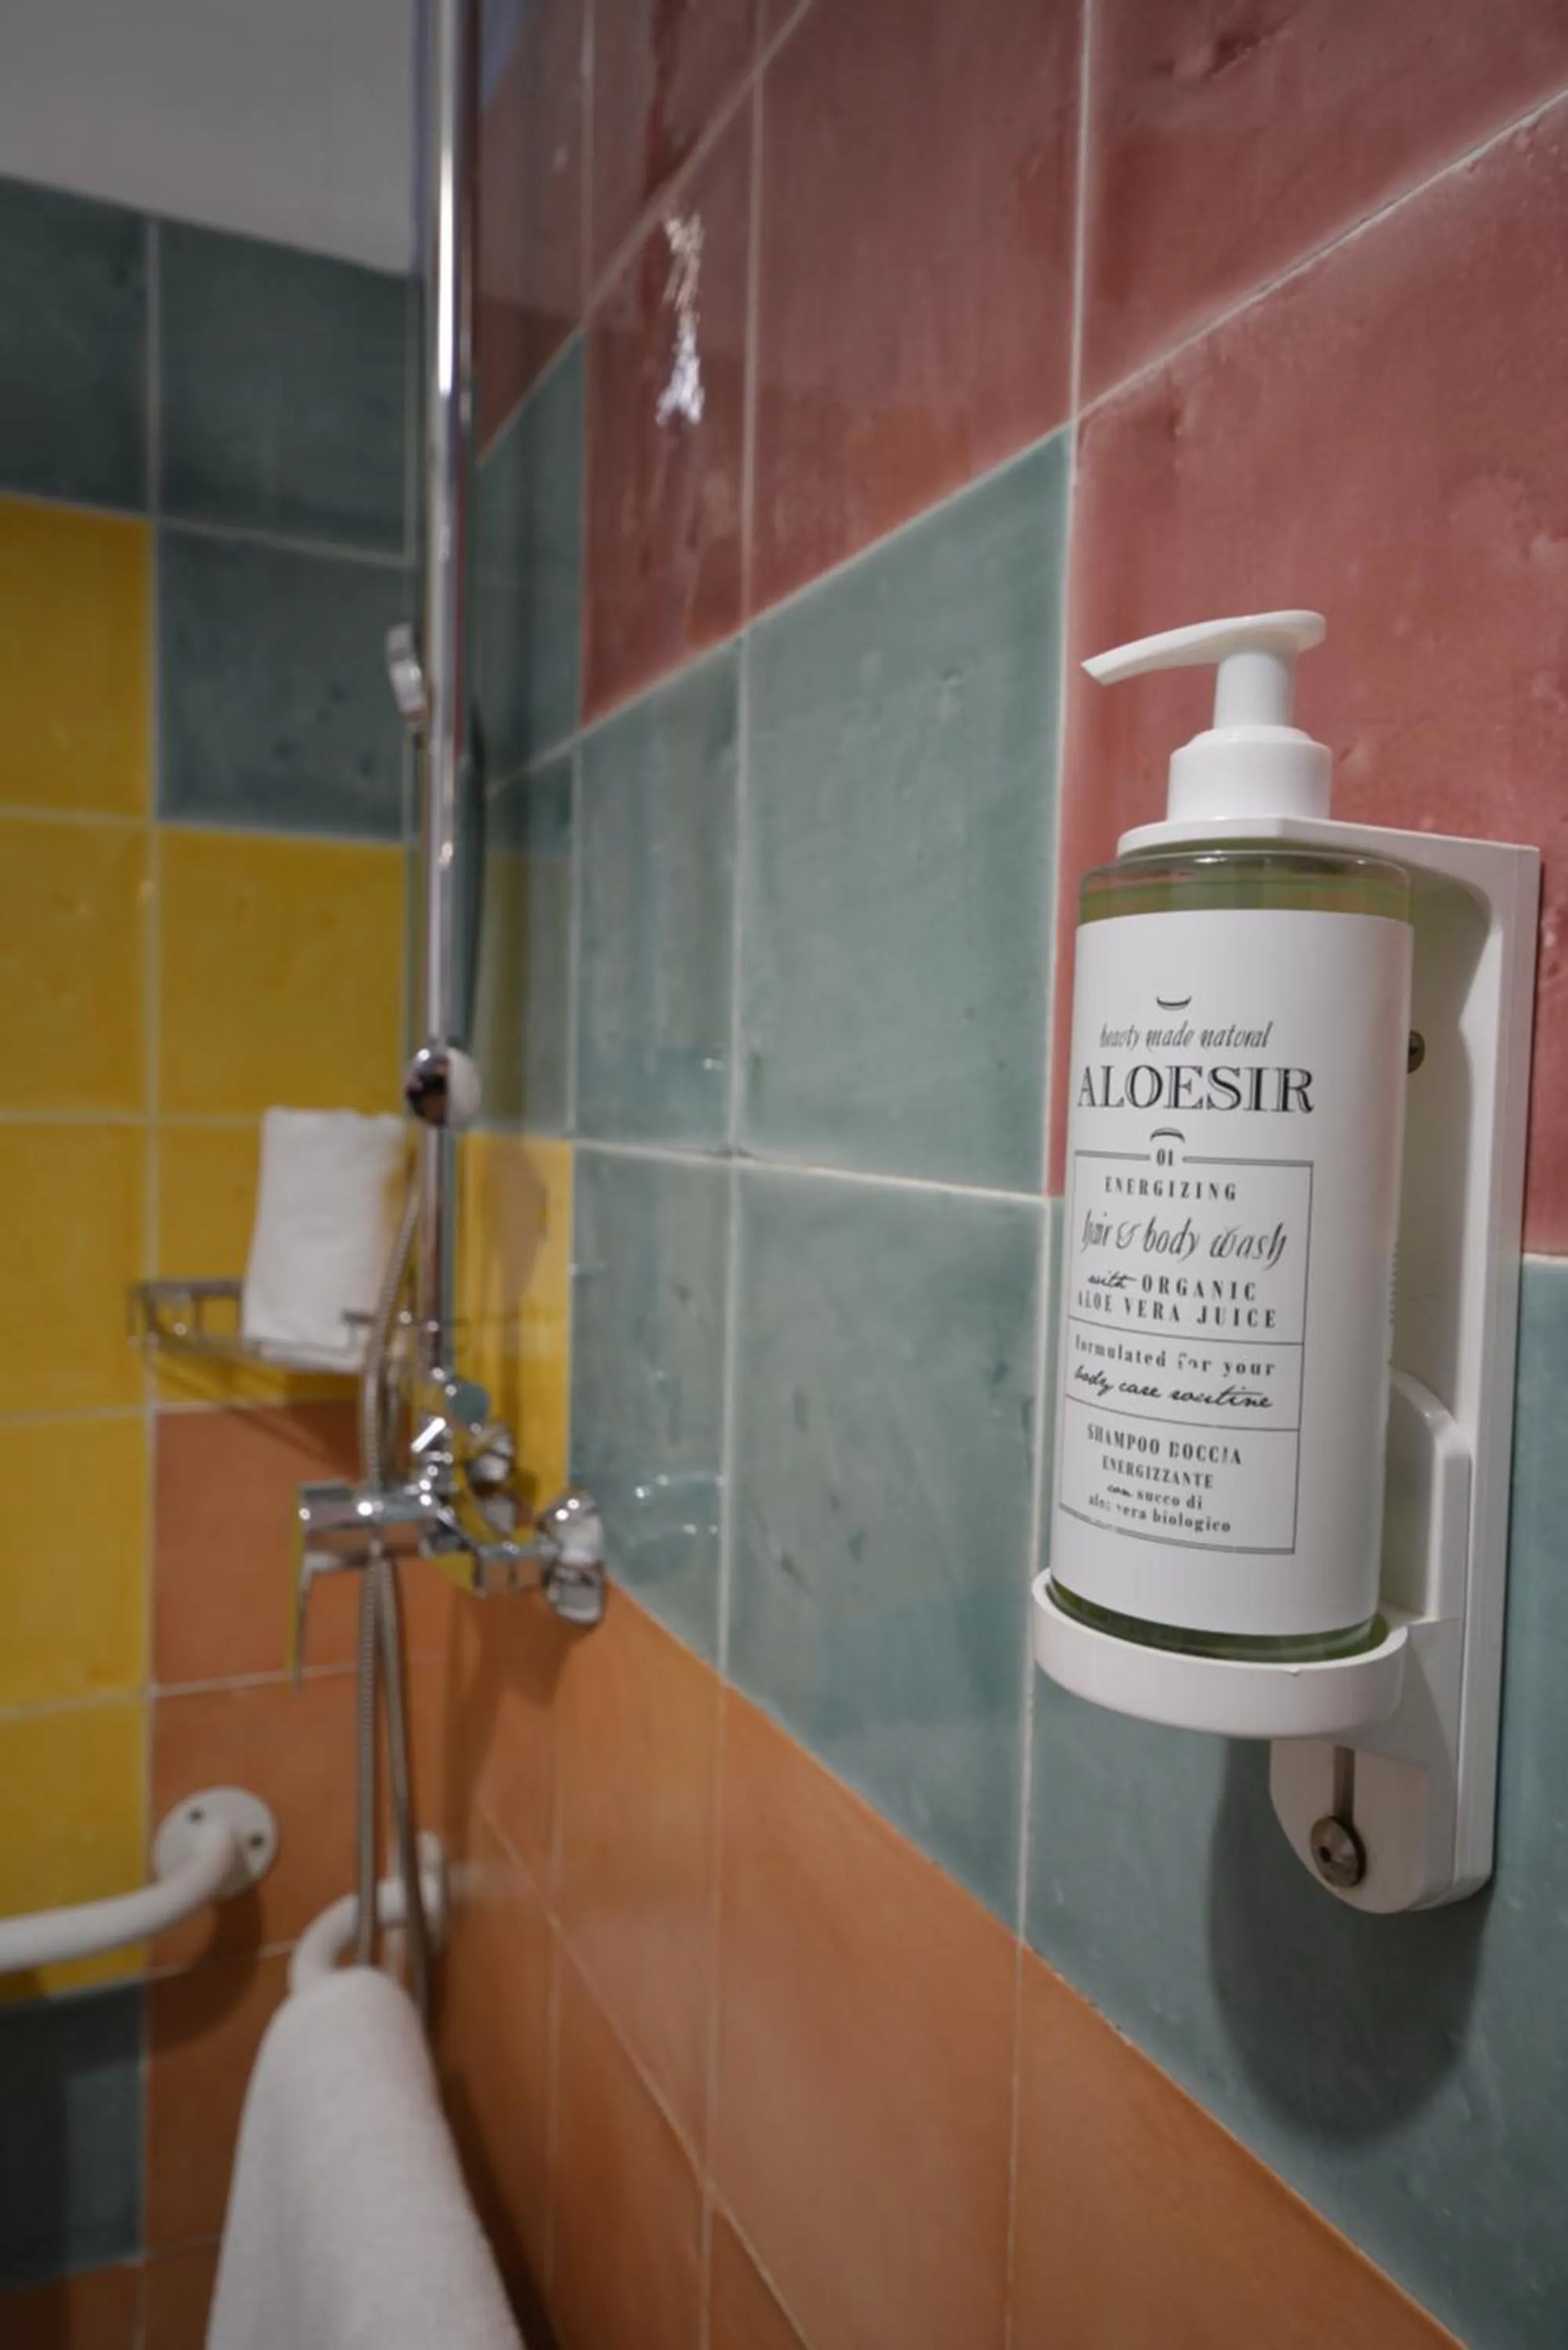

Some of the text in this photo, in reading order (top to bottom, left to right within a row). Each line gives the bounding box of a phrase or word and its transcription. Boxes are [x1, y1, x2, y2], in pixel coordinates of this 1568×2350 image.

[1100, 1020, 1274, 1052] beauty made natural
[1078, 1065, 1314, 1113] ALOESIR
[1105, 1176, 1237, 1201] ENERGIZING
[1082, 1209, 1288, 1271] hair & body wash
[1087, 1271, 1257, 1301] with ORGANIC
[1078, 1290, 1276, 1327] ALOE VERA JUICE
[1075, 1334, 1276, 1377] formulated for your
[1075, 1364, 1273, 1408] body care routine
[1087, 1423, 1241, 1465] SHAMPOO DOCCIA
[1102, 1455, 1213, 1488] ENERGIZZANTE
[1107, 1484, 1202, 1510] con succo di
[1116, 1503, 1147, 1520] vera
[1152, 1508, 1231, 1533] biologico
